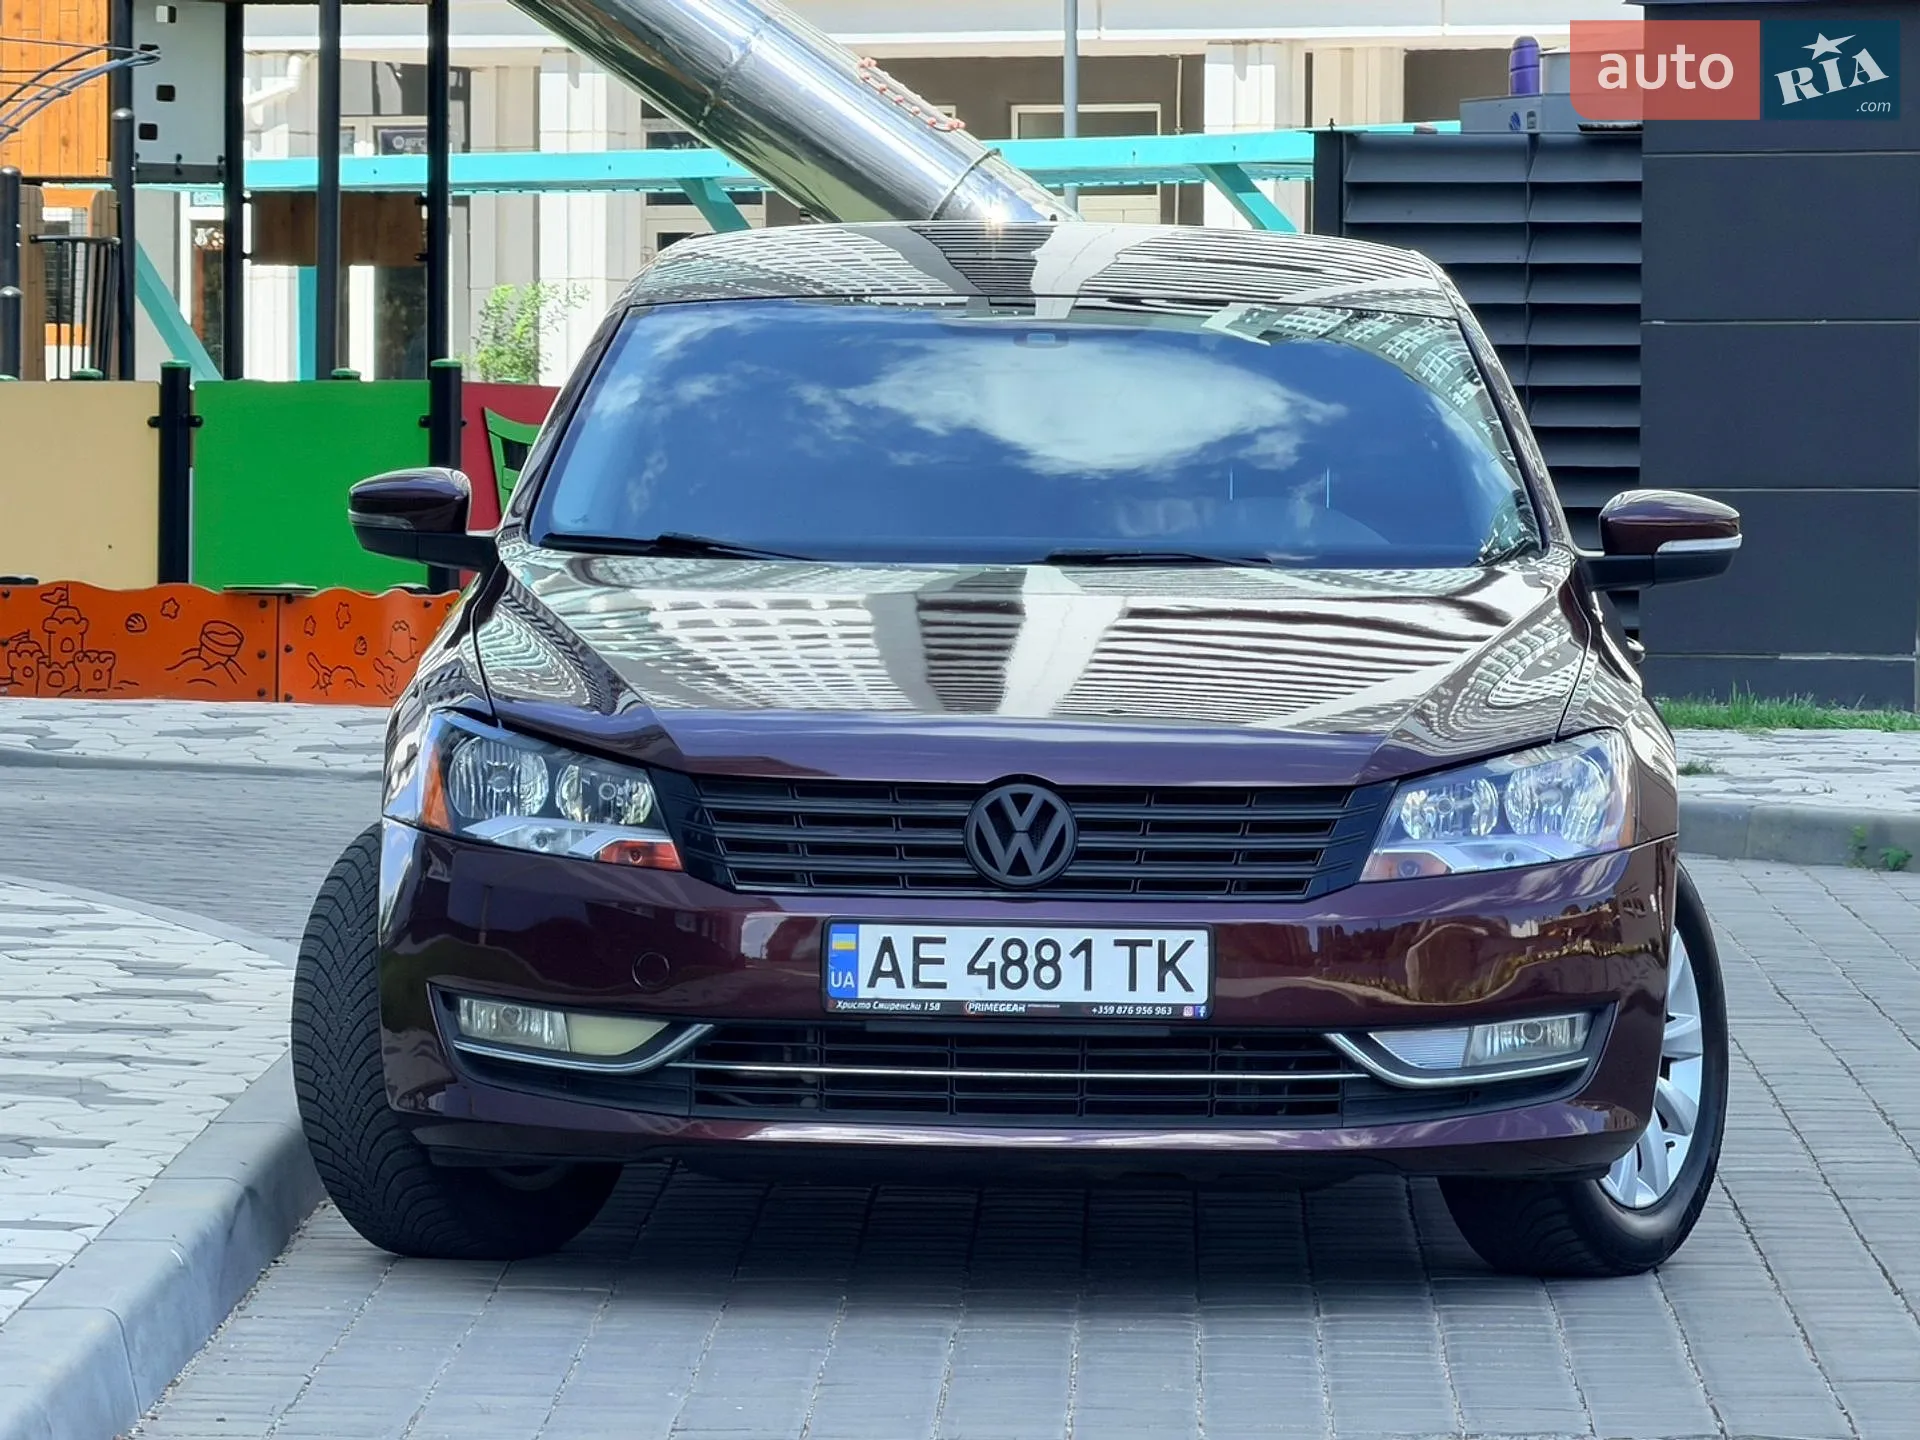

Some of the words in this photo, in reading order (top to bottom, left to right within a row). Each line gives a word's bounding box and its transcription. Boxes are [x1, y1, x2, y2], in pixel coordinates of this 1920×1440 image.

[830, 971, 856, 989] UA
[867, 936, 948, 989] AE
[966, 937, 1093, 991] 4881
[1113, 939, 1196, 993] TK
